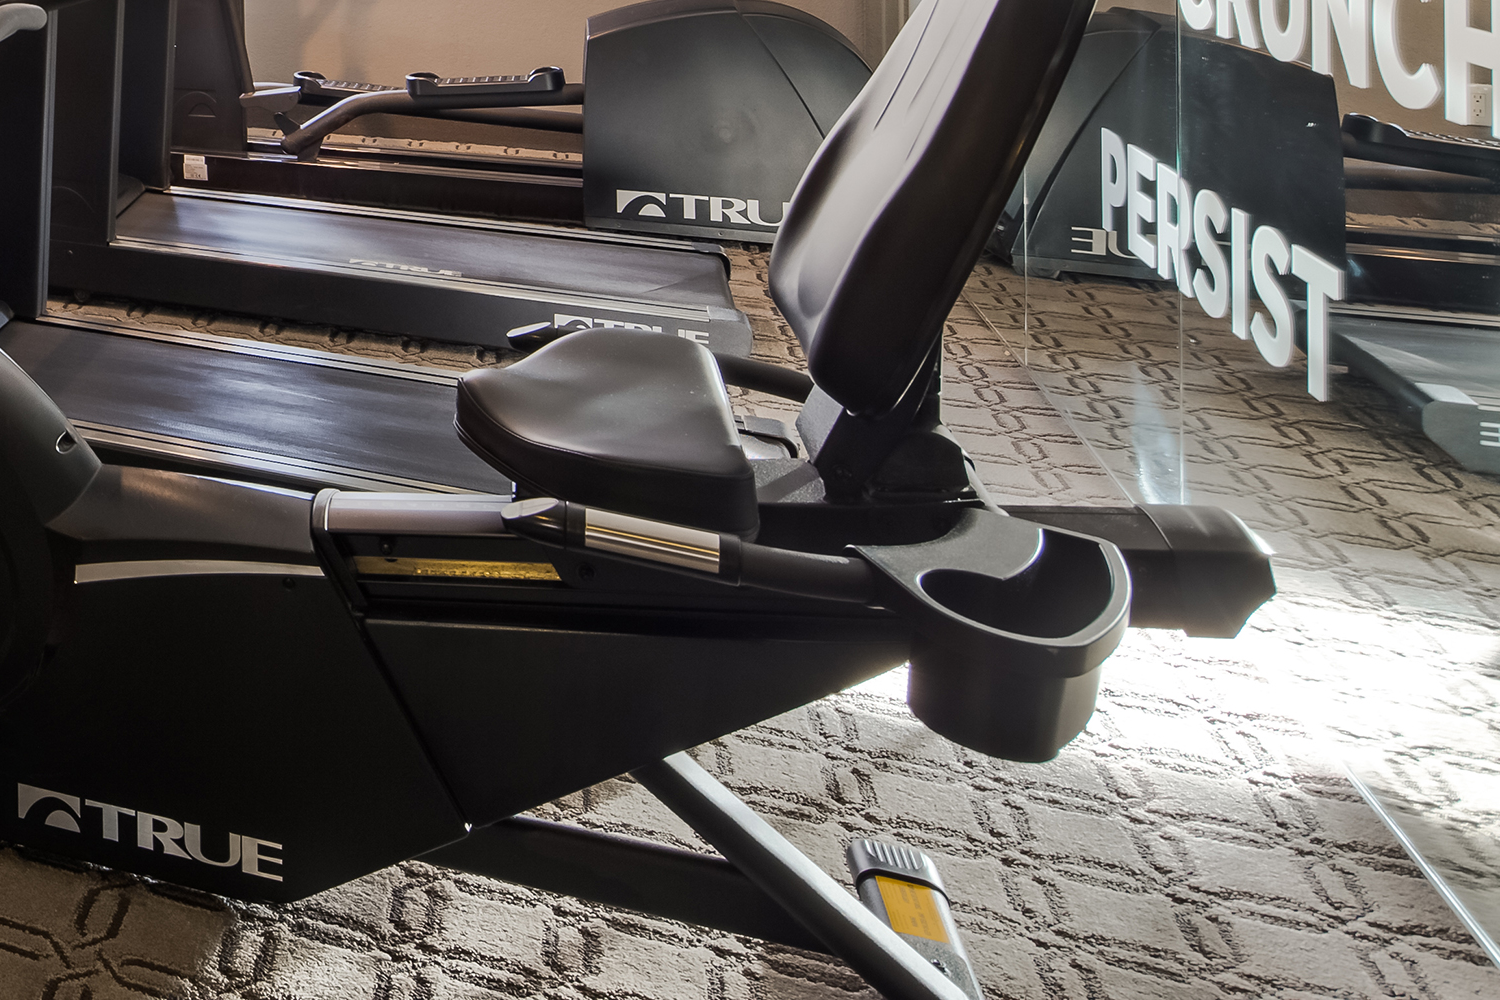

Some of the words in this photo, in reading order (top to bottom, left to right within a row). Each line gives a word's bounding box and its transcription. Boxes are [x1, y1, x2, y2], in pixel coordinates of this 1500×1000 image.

[669, 193, 790, 227] TRU
[1101, 128, 1346, 402] PERSIST
[85, 799, 283, 882] TRUE
